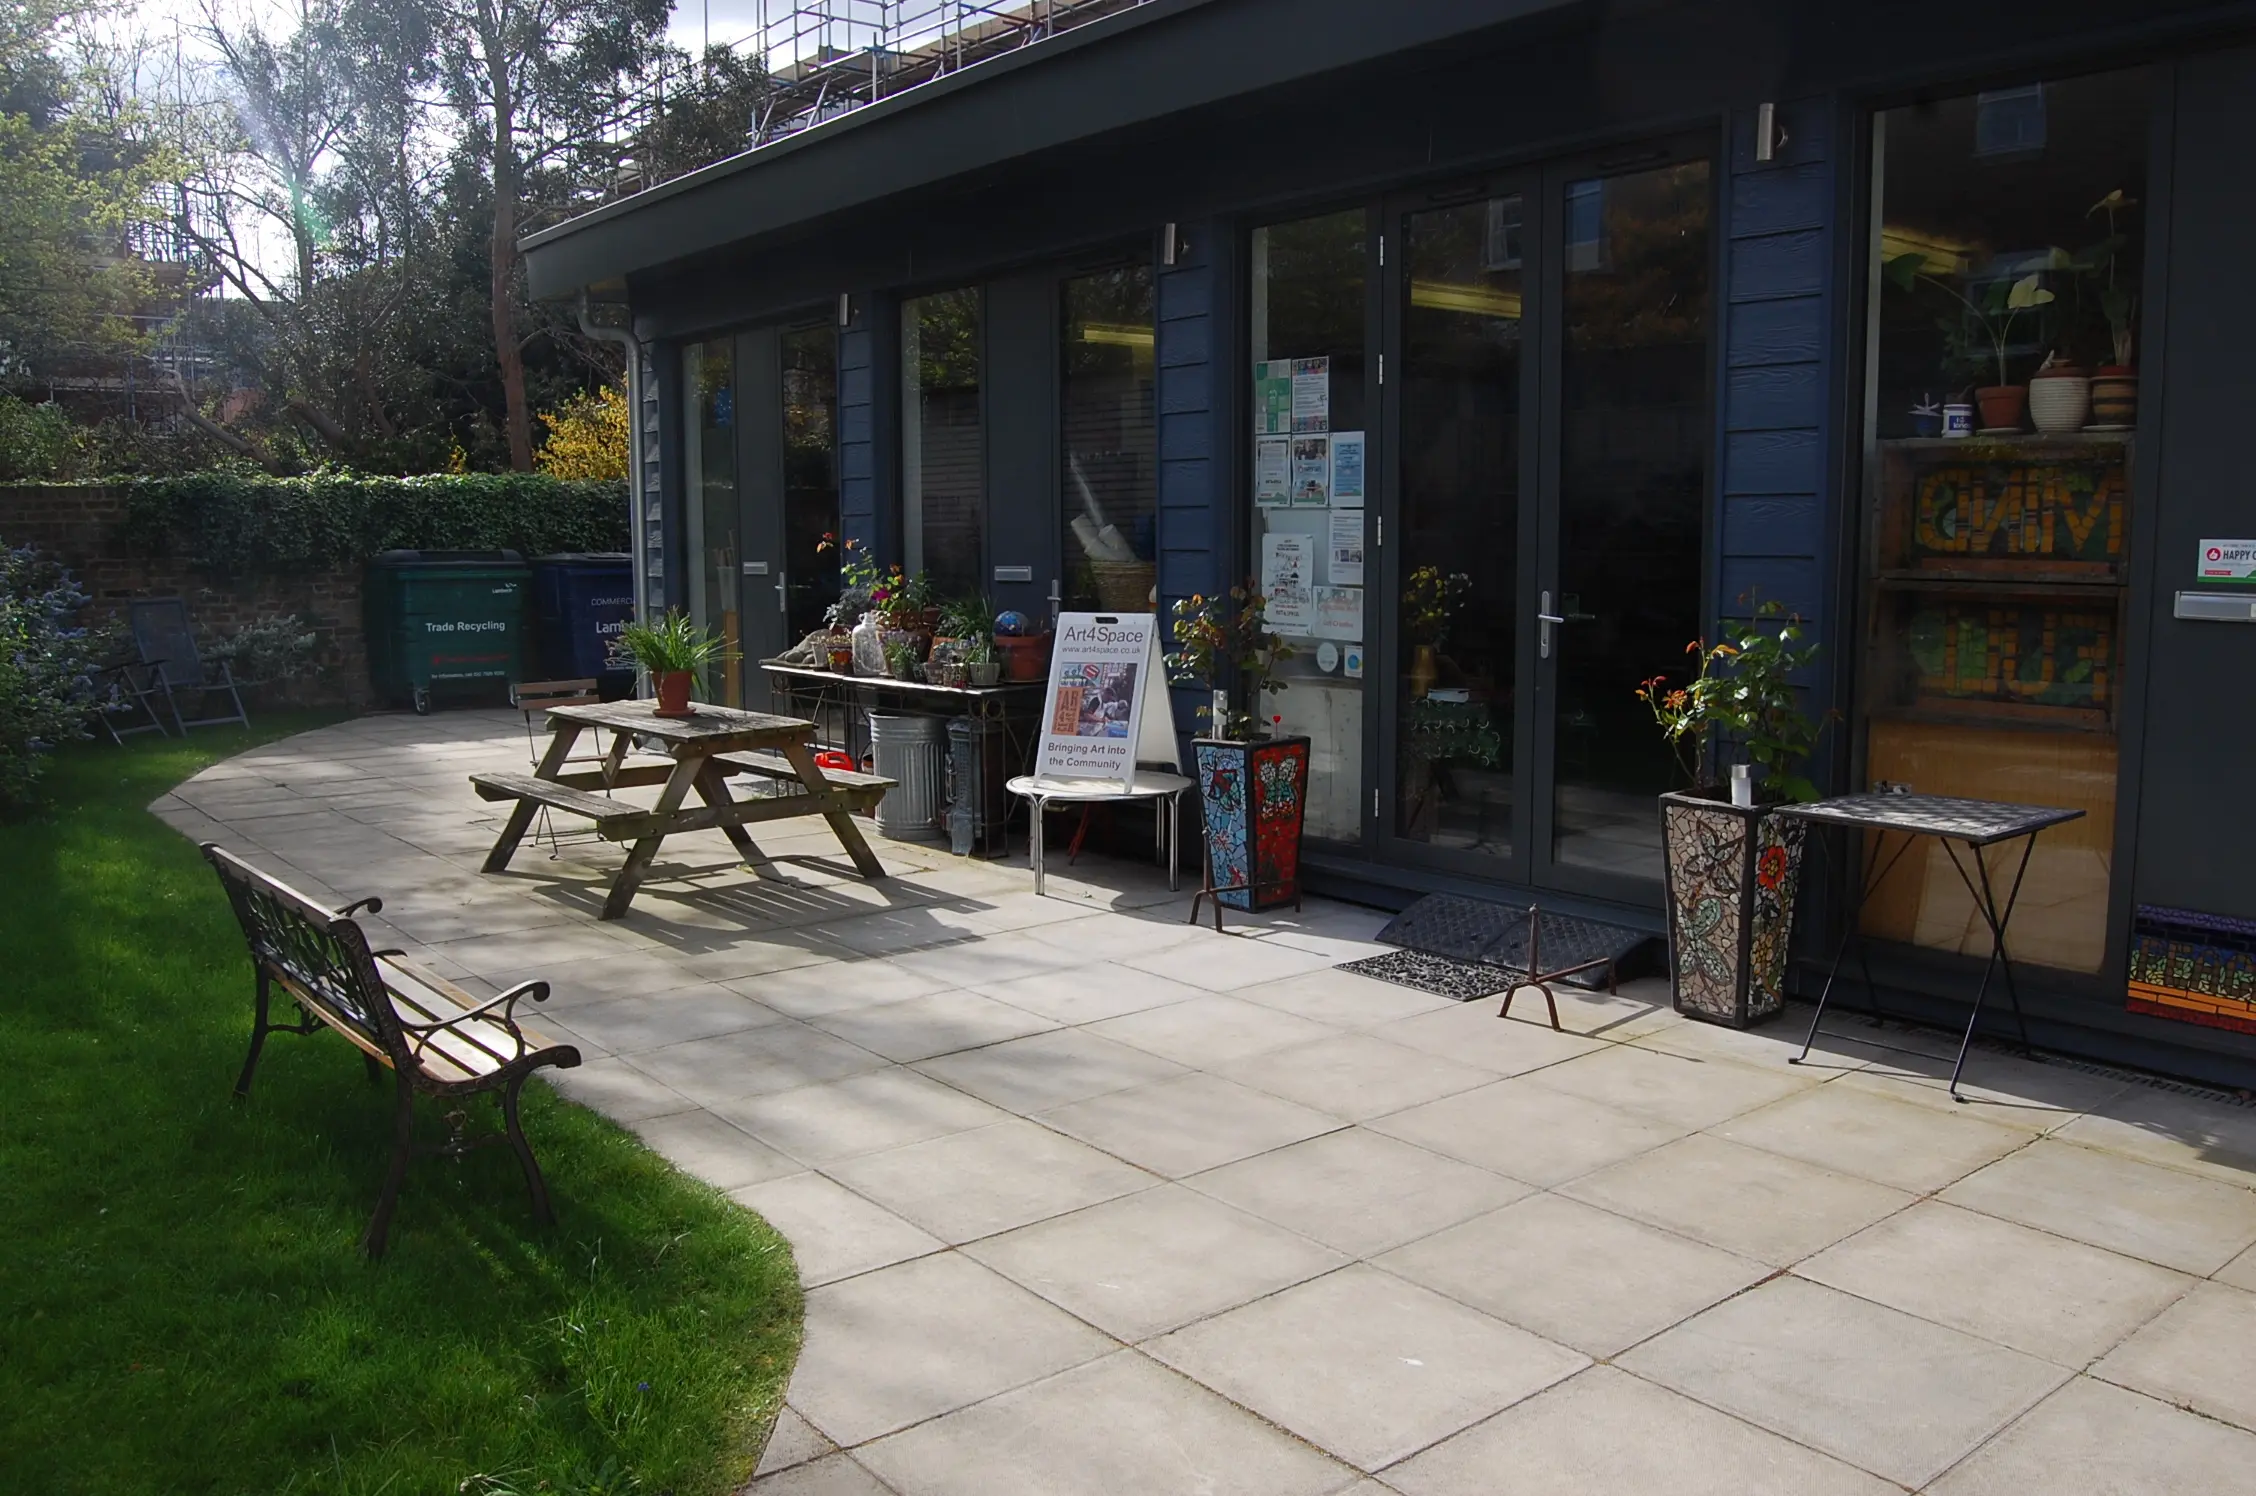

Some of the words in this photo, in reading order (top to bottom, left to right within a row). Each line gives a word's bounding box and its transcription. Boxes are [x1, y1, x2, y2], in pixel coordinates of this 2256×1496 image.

[2223, 550, 2250, 560] HAPPY
[425, 622, 454, 632] Trade
[457, 621, 505, 632] Recycling
[1064, 626, 1143, 645] Art4Space
[1062, 646, 1141, 654] www.art4space.co.uk
[1048, 743, 1088, 755] Bringing
[1090, 744, 1105, 755] Art
[1107, 745, 1126, 755] into
[1049, 756, 1063, 766] the
[1066, 757, 1121, 770] Community
